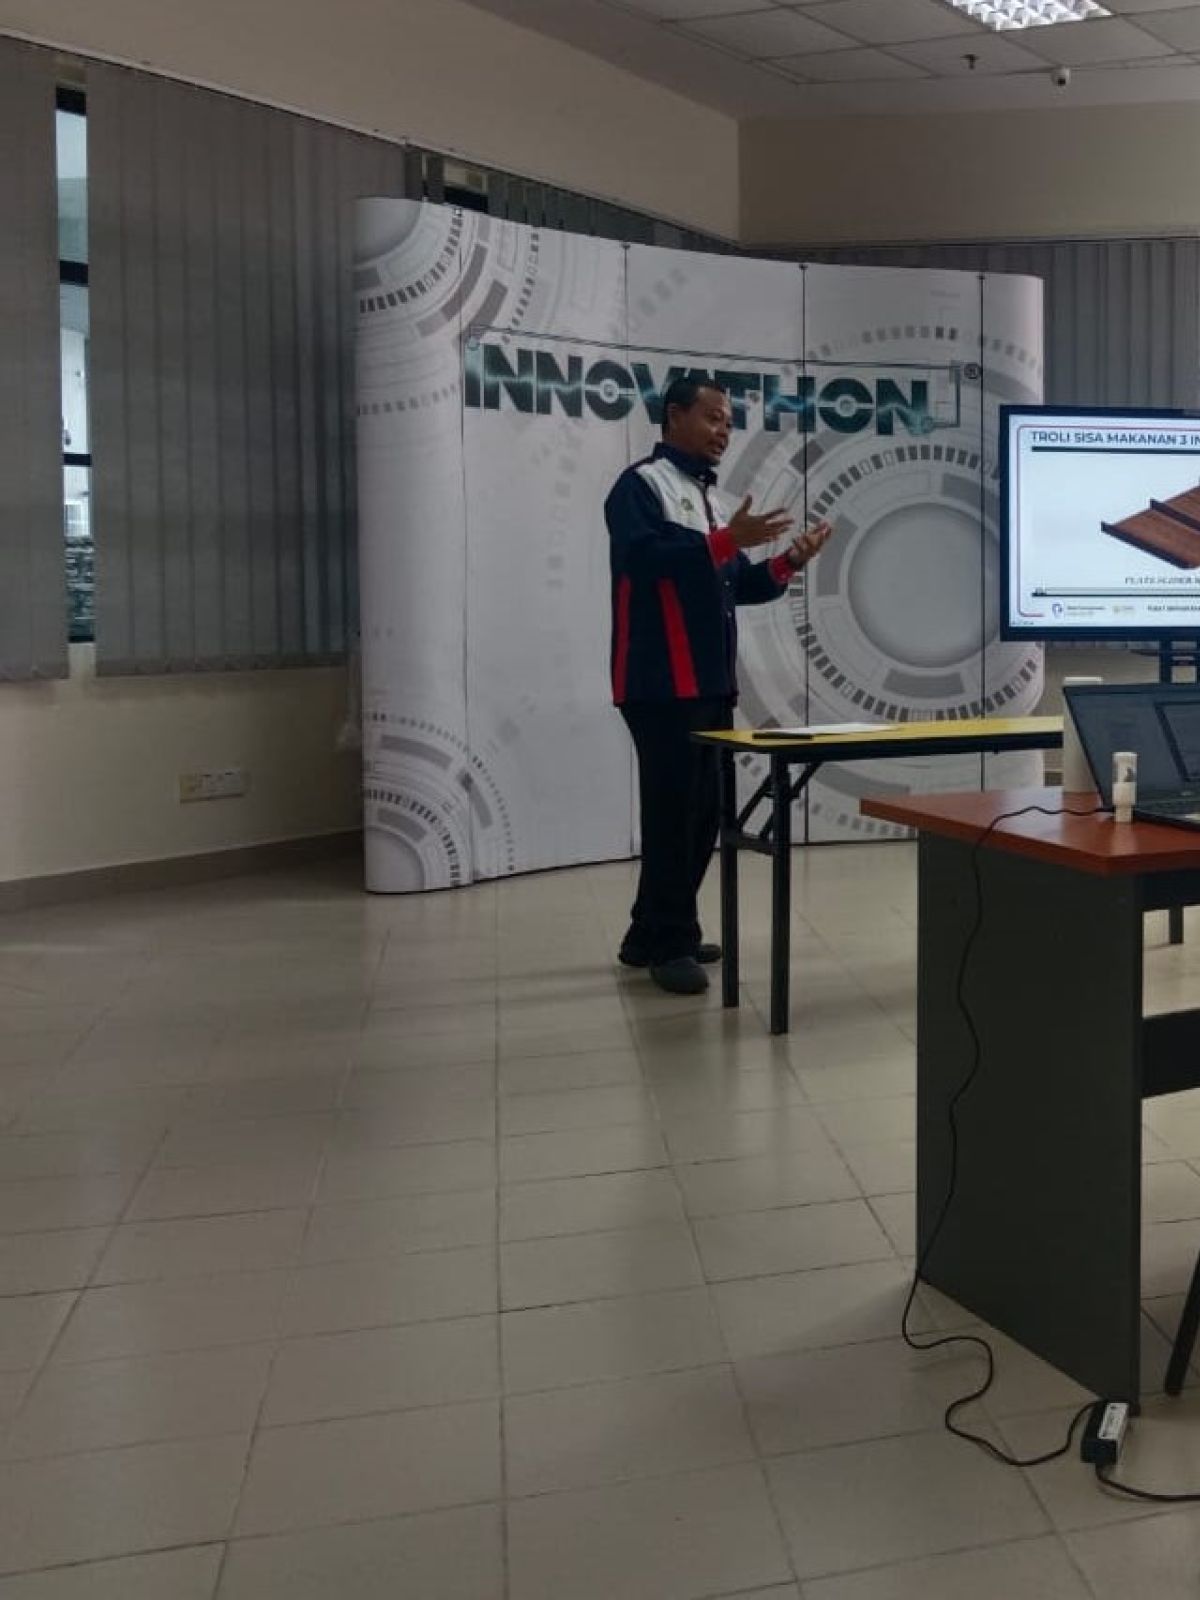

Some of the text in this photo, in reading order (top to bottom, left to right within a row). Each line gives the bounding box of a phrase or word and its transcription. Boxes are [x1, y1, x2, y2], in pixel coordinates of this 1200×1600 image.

[464, 339, 931, 437] INNOVTHON
[1031, 430, 1070, 443] TROLI
[1074, 432, 1104, 444] SISA
[1107, 433, 1177, 446] MAKANAN
[1179, 435, 1188, 446] 3
